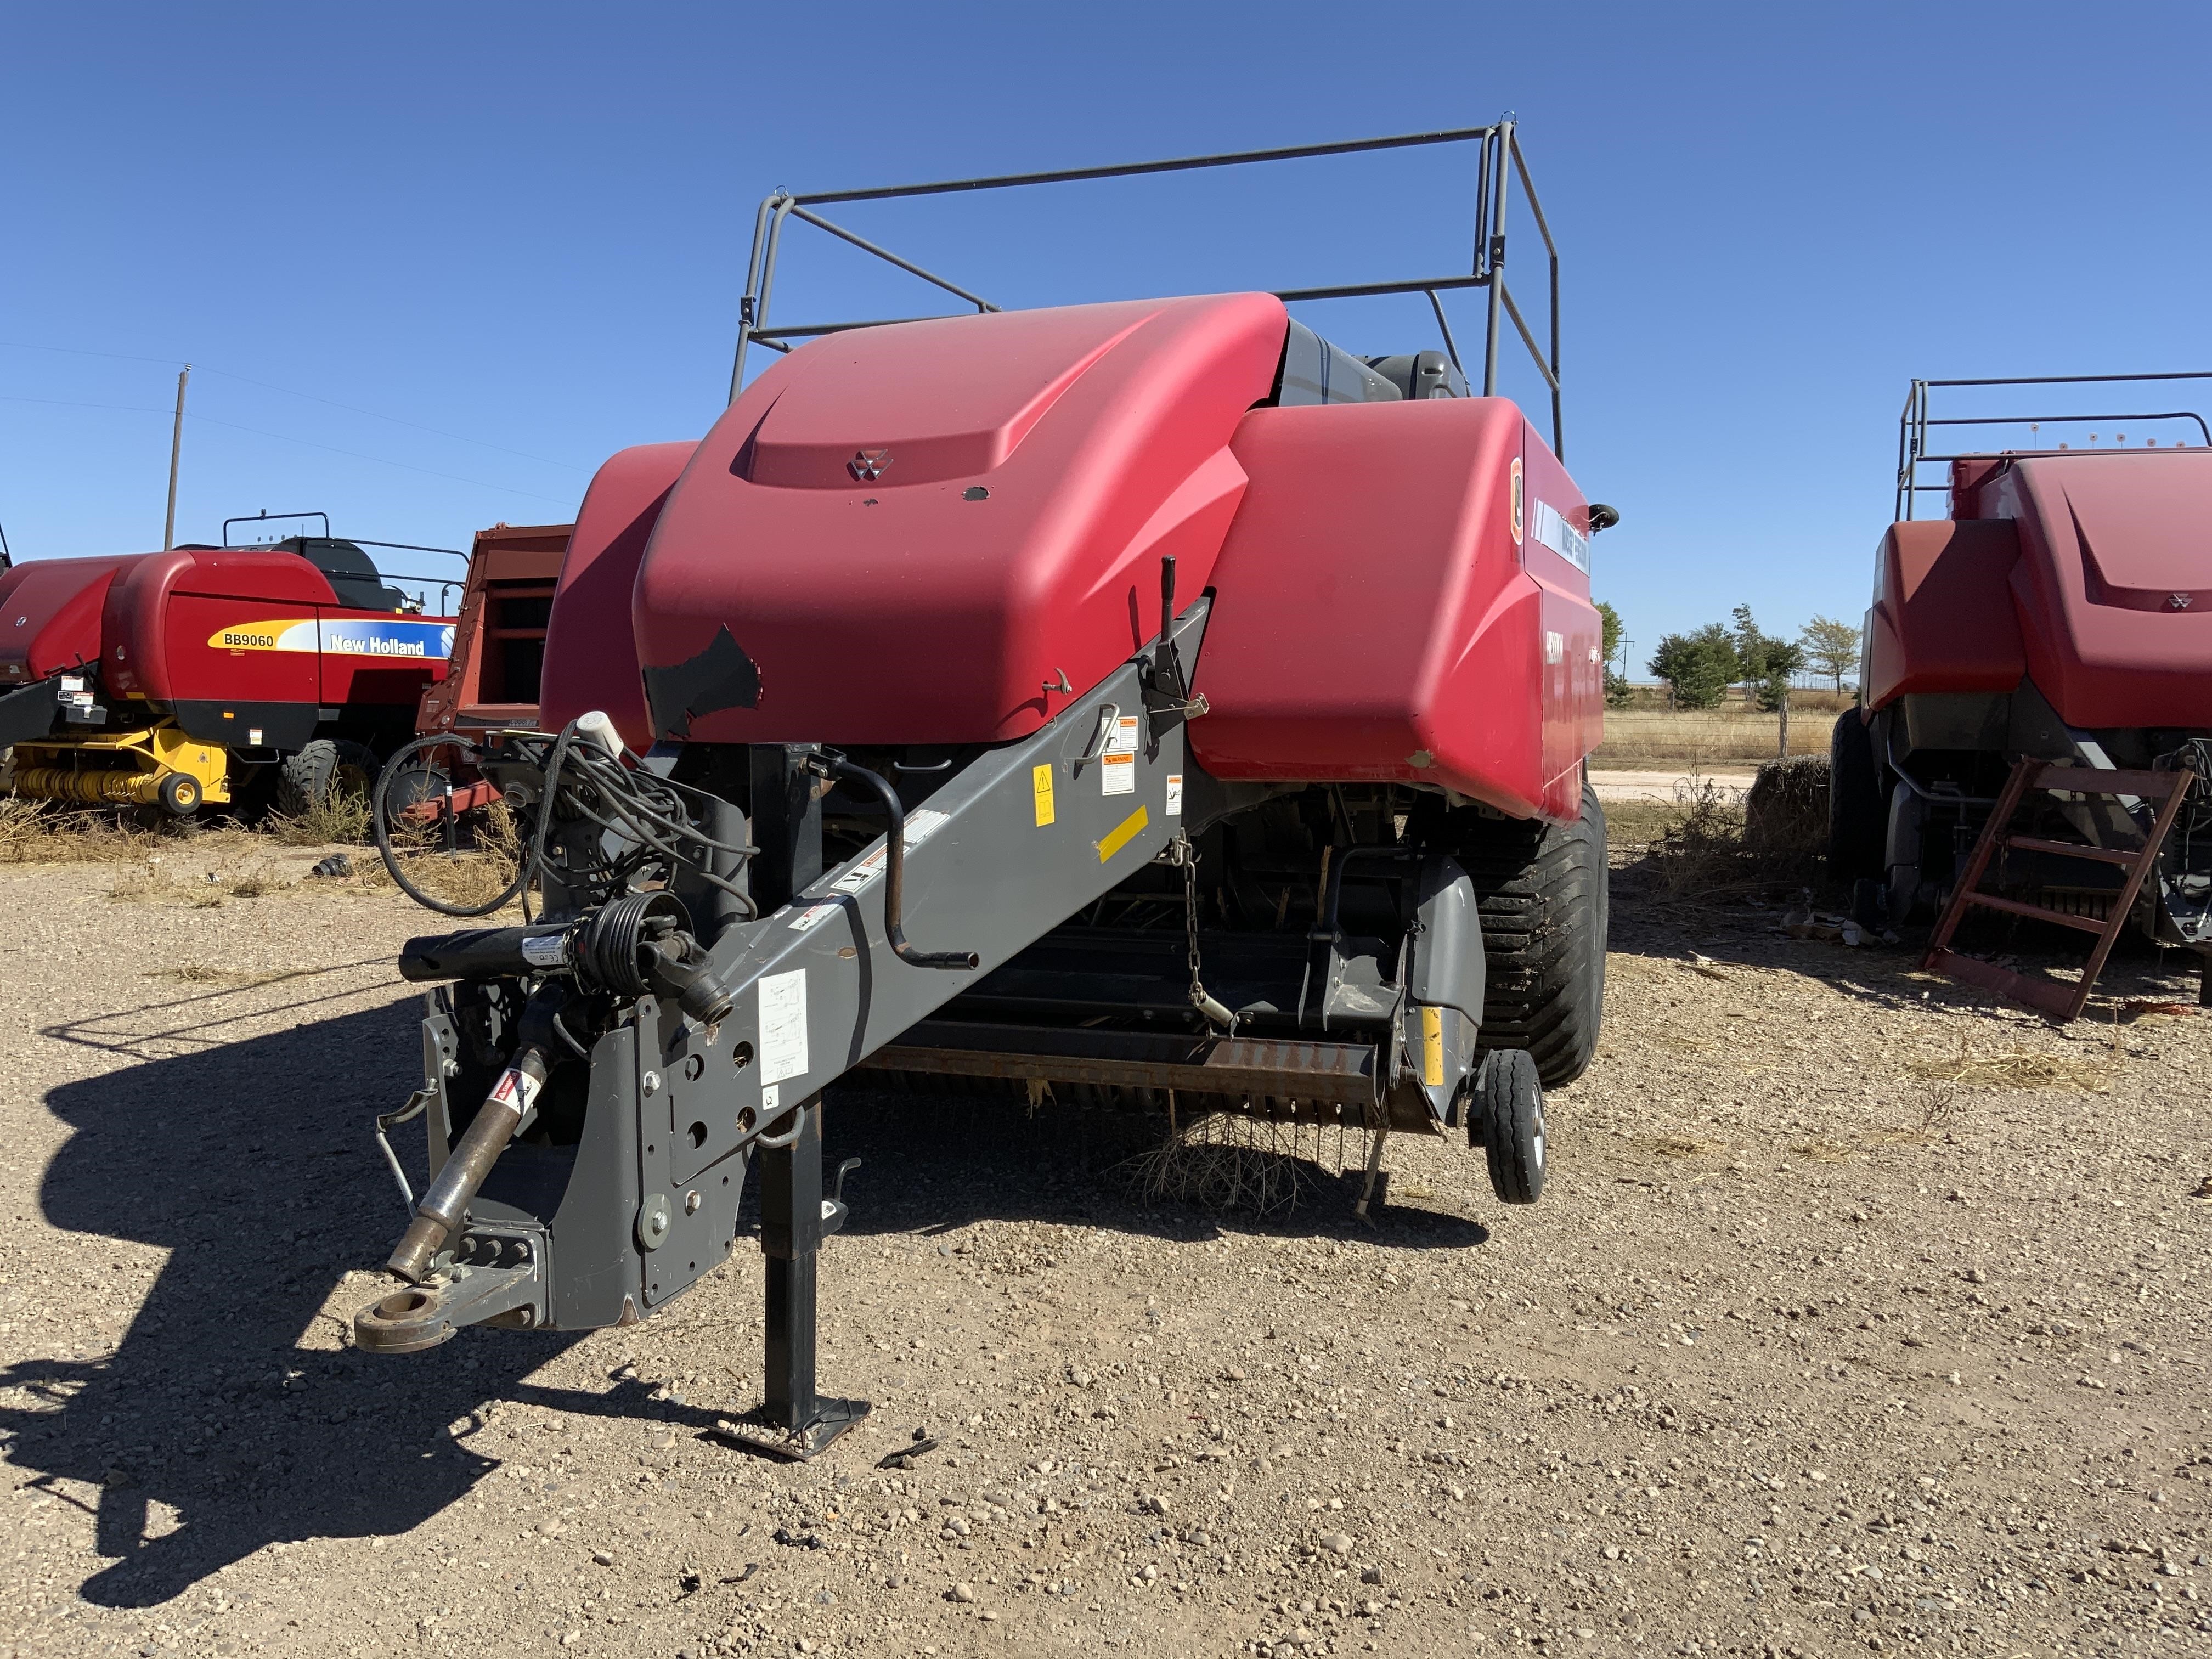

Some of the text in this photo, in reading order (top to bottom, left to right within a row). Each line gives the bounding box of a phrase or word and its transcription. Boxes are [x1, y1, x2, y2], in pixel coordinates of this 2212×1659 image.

[224, 634, 273, 646] BB9060
[330, 634, 424, 656] New Holland
[503, 1072, 518, 1093] DANGER
